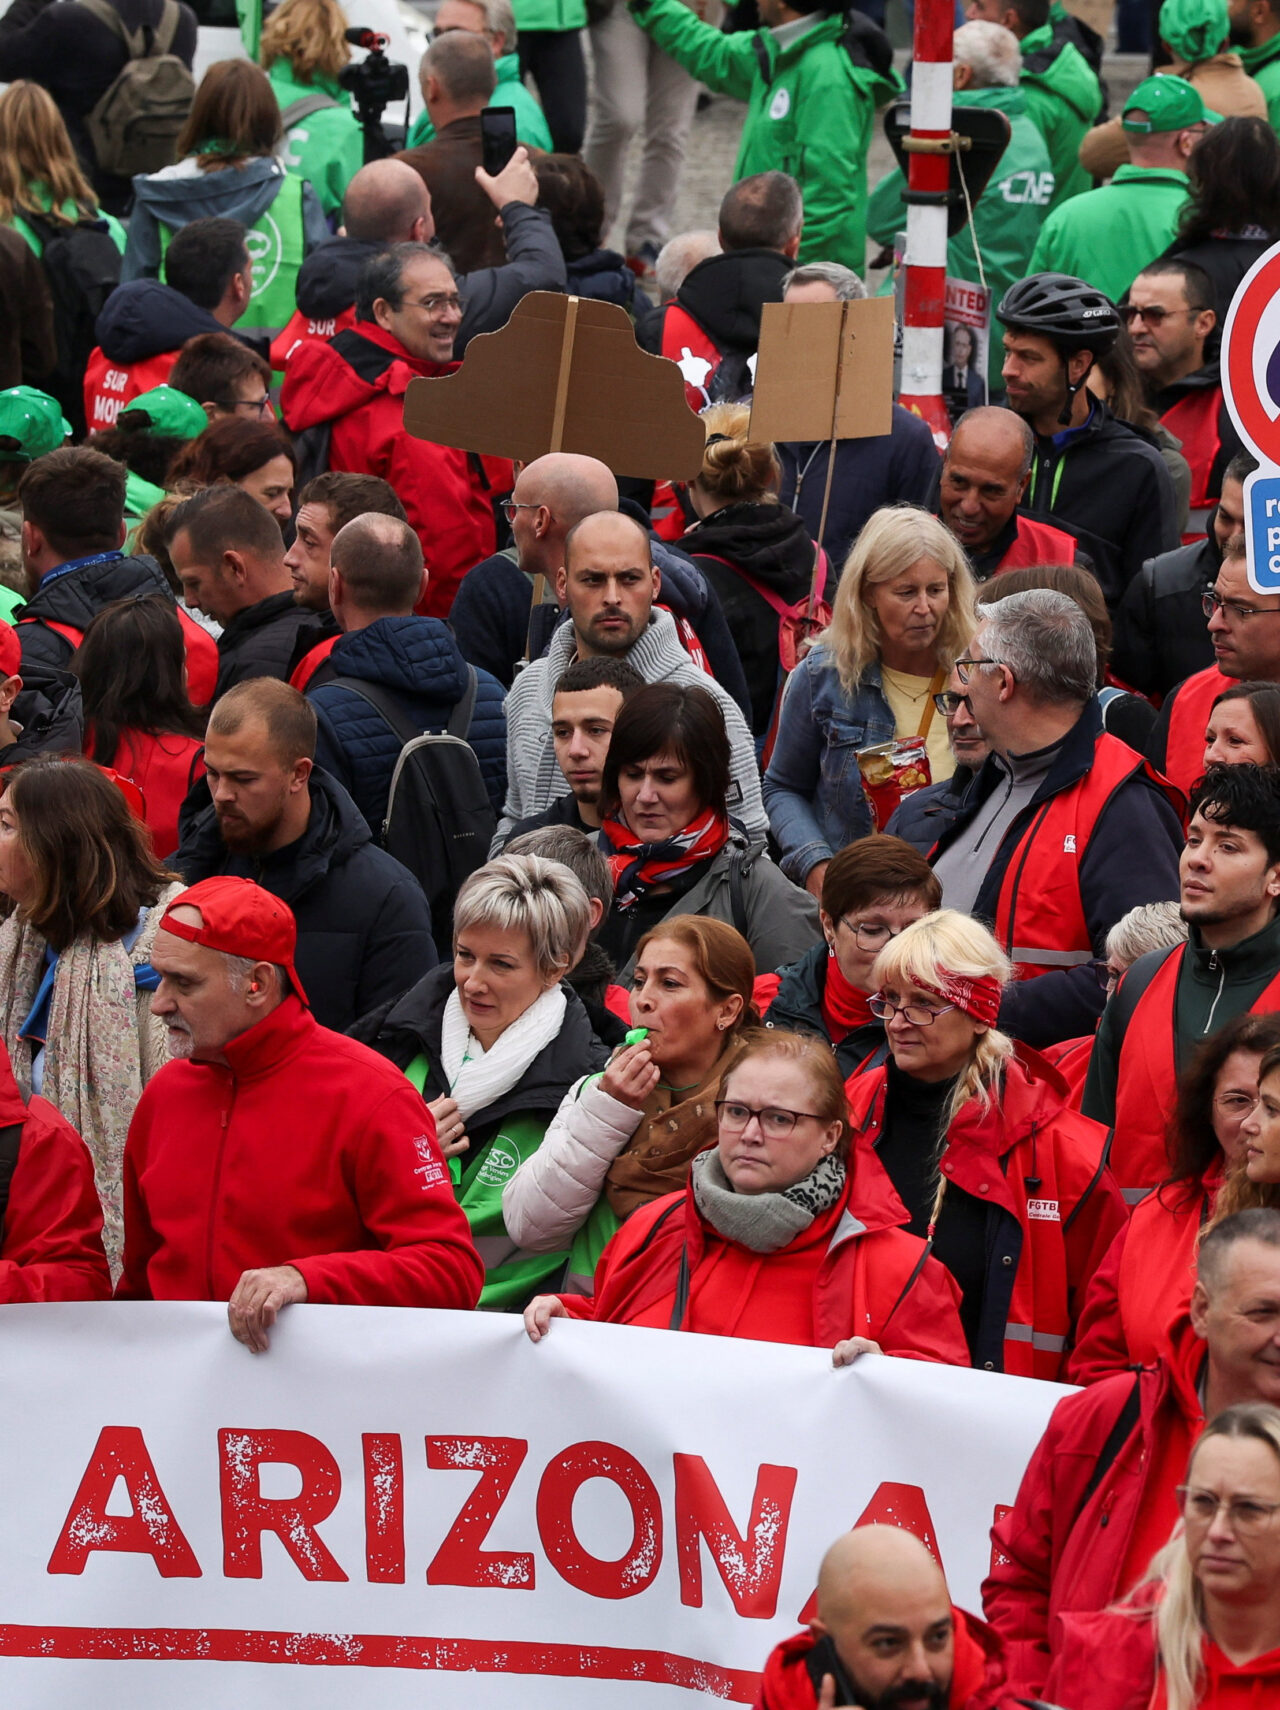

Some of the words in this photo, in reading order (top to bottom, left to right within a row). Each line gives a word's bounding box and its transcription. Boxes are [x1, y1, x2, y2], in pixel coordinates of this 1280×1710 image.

[946, 285, 987, 312] NTED
[308, 318, 335, 336] SUR
[103, 369, 129, 392] SUR
[1029, 1201, 1057, 1211] FGTB
